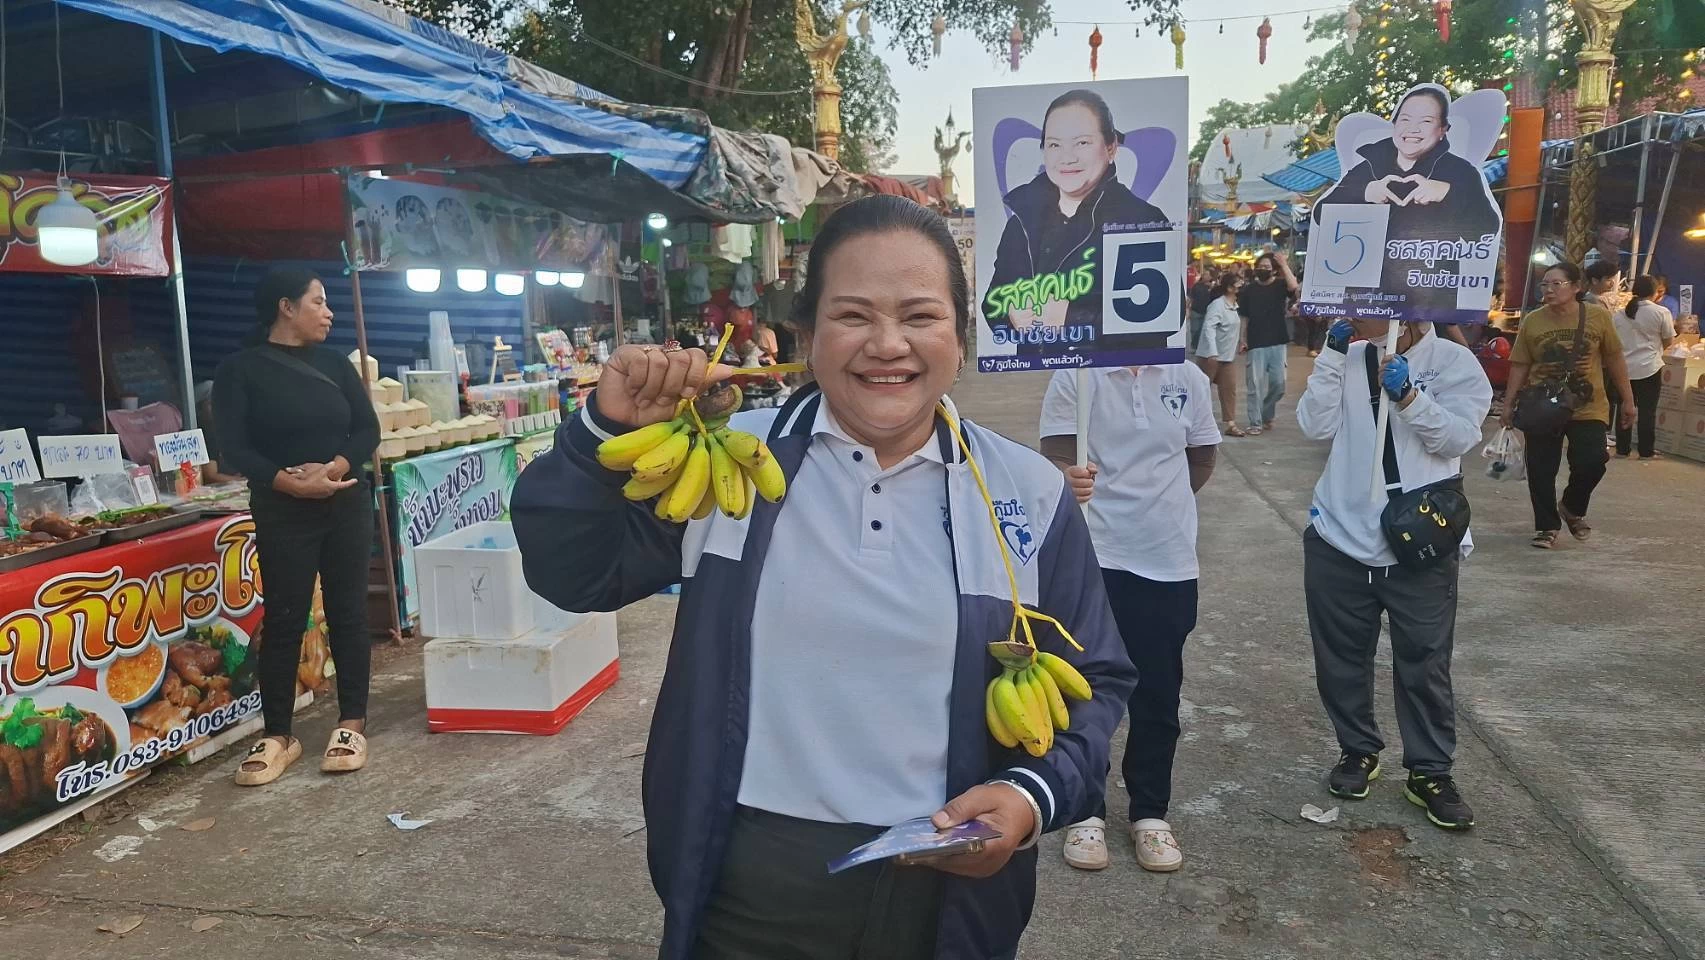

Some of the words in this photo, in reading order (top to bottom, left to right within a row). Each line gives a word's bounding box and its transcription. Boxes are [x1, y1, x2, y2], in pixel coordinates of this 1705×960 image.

[1325, 220, 1372, 275] 5
[1386, 233, 1496, 268] รสสุคนธ์
[986, 246, 1096, 318] รสสุคนธ์
[1112, 241, 1170, 323] 5
[1407, 269, 1490, 288] อินชัยเขา
[992, 320, 1095, 345] อินชัยเขา
[996, 359, 1030, 371] ภูมิใจไทย
[1041, 354, 1083, 367] พูดแล้วทำ
[1, 459, 30, 481] บาท
